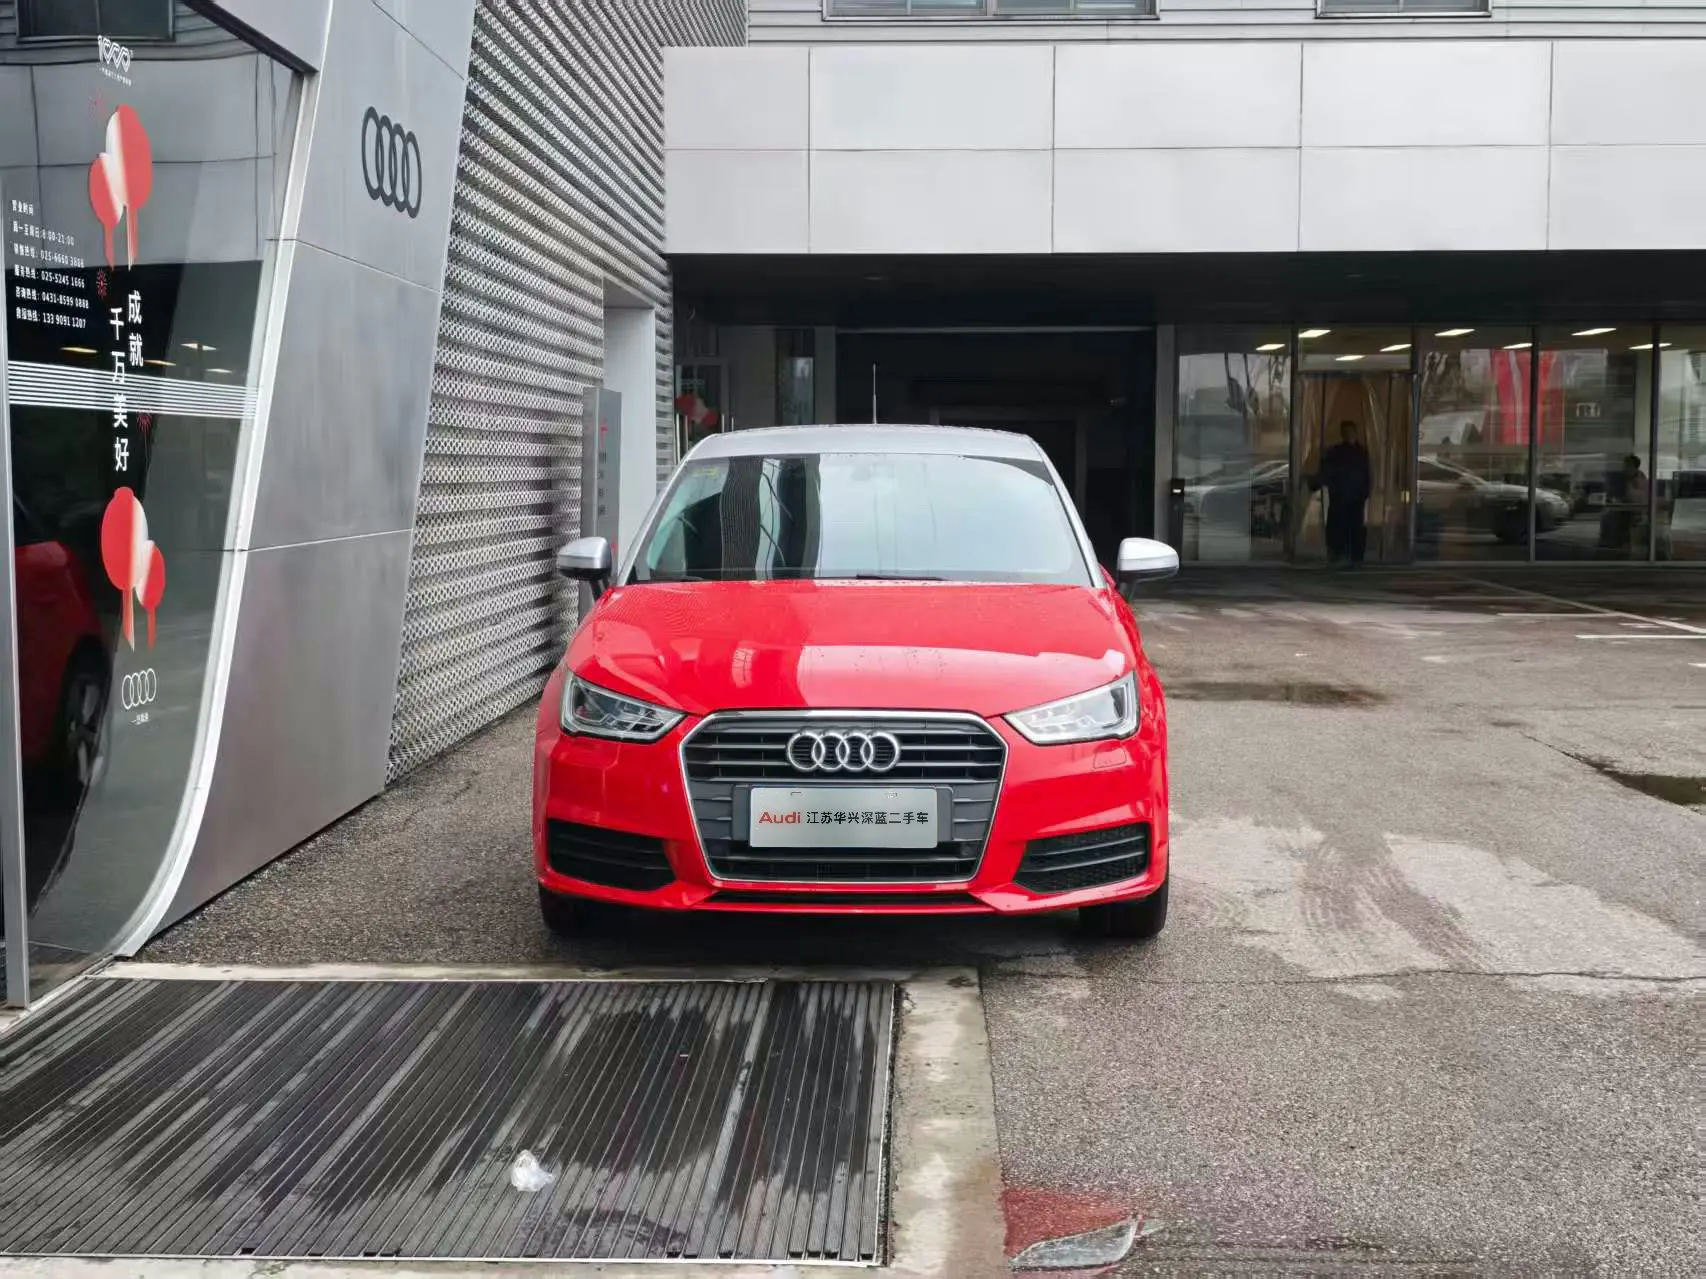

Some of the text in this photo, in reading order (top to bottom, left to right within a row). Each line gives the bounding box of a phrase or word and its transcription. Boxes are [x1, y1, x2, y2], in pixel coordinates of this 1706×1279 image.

[42, 312, 55, 325] 133
[72, 316, 86, 329] 1207
[127, 289, 144, 367] 成就
[109, 307, 130, 471] 千万美好
[758, 811, 929, 825] Audi 江苏华兴深蓝二手车
